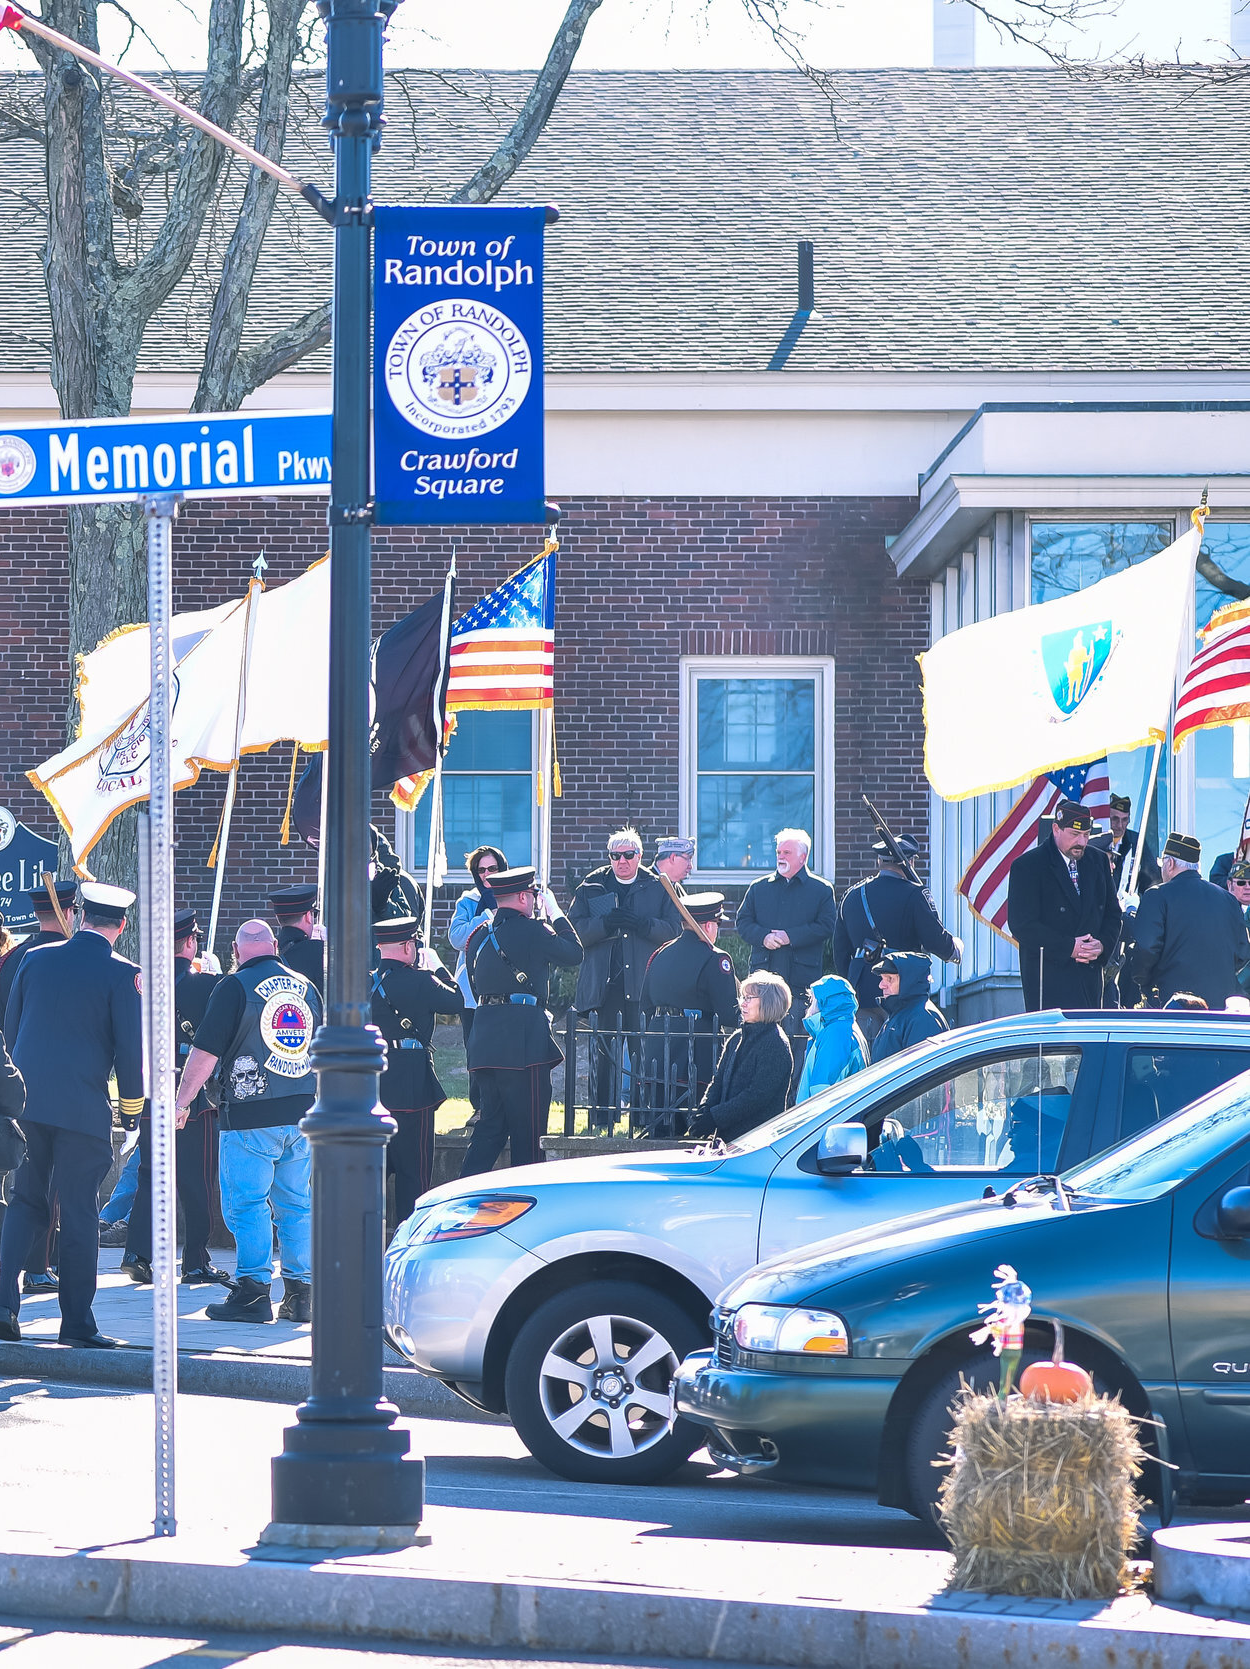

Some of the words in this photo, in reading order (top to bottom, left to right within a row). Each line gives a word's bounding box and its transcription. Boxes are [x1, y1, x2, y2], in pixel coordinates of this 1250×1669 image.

[407, 235, 477, 257] Town
[485, 235, 516, 261] of
[384, 259, 534, 292] Randolph
[389, 322, 419, 380] TOWN
[419, 305, 445, 325] OF
[452, 303, 529, 374] RANDOLPH
[405, 401, 488, 435] Incorporated
[490, 396, 518, 424] 1793
[49, 424, 254, 493] Memorial
[400, 447, 519, 473] Crawford
[414, 475, 504, 499] Square
[6, 913, 27, 923] Town
[258, 977, 291, 998] CHAPTER
[298, 984, 306, 996] 51
[1212, 1362, 1249, 1374] QU
